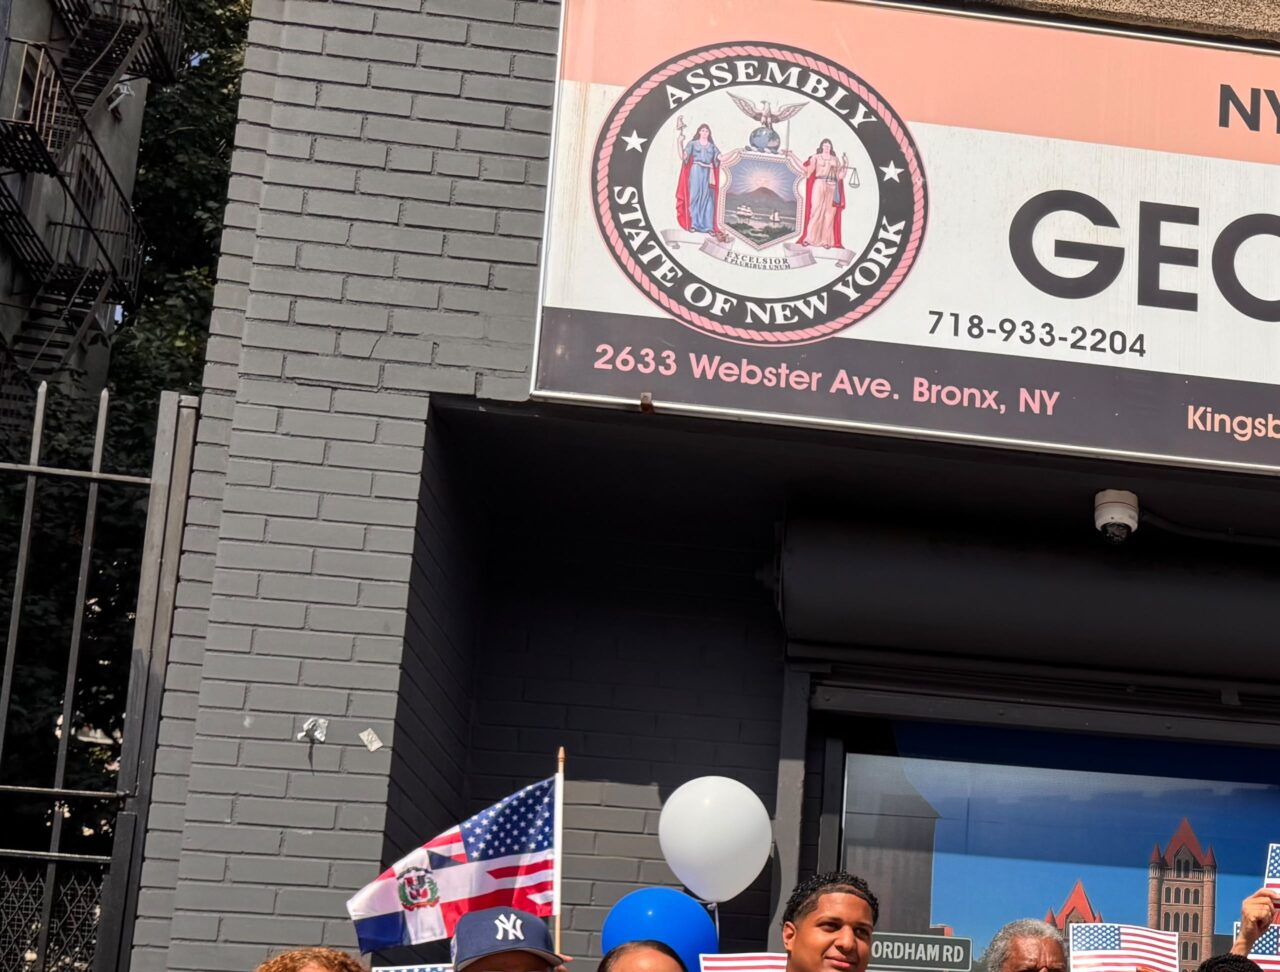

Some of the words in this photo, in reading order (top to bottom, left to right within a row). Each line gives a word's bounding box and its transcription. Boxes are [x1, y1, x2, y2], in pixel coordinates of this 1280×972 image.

[665, 60, 879, 129] ASSEMBLY
[613, 185, 683, 288] STATE
[683, 281, 738, 318] OF
[744, 290, 829, 325] NEW
[832, 215, 907, 302] YORK
[726, 251, 789, 265] EXCELSIOR
[928, 310, 1147, 358] 718-933-2204
[594, 343, 678, 377] 2633
[690, 352, 821, 392] Webster
[829, 366, 899, 401] Ave.
[912, 376, 1006, 414] Bronx,
[1018, 387, 1061, 416] NY
[494, 913, 525, 940] NY
[871, 940, 940, 963] ORDHAM
[942, 945, 964, 963] RD
